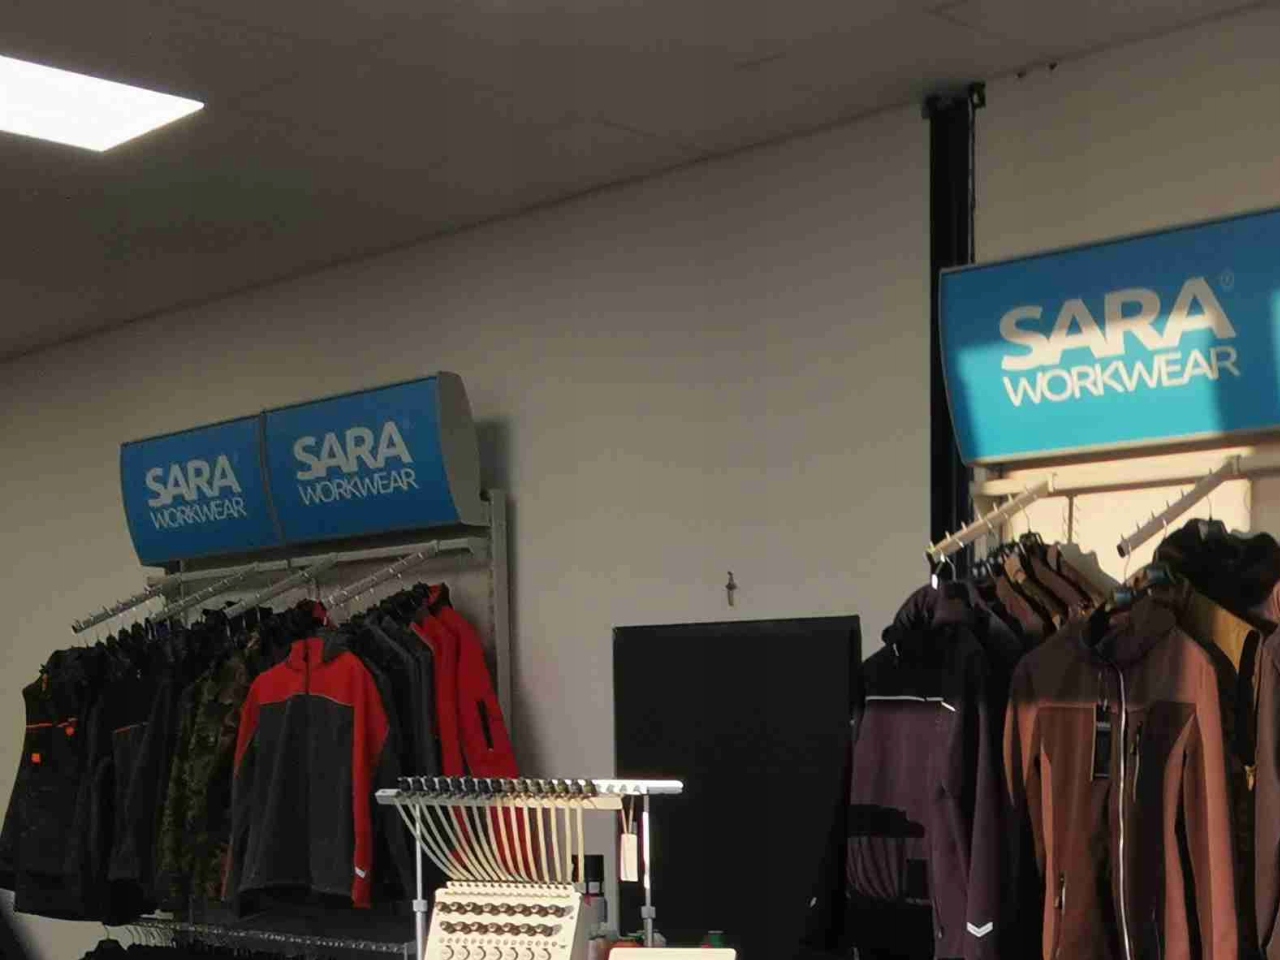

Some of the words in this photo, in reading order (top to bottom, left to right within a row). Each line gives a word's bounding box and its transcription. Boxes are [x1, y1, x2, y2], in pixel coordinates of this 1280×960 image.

[999, 276, 1237, 371] SARA
[1003, 345, 1240, 407] WORKWEAR
[293, 421, 414, 480] SARA
[145, 455, 242, 508] SARA
[298, 467, 419, 506] WORKWEAR
[150, 497, 247, 529] WORKWEAR
